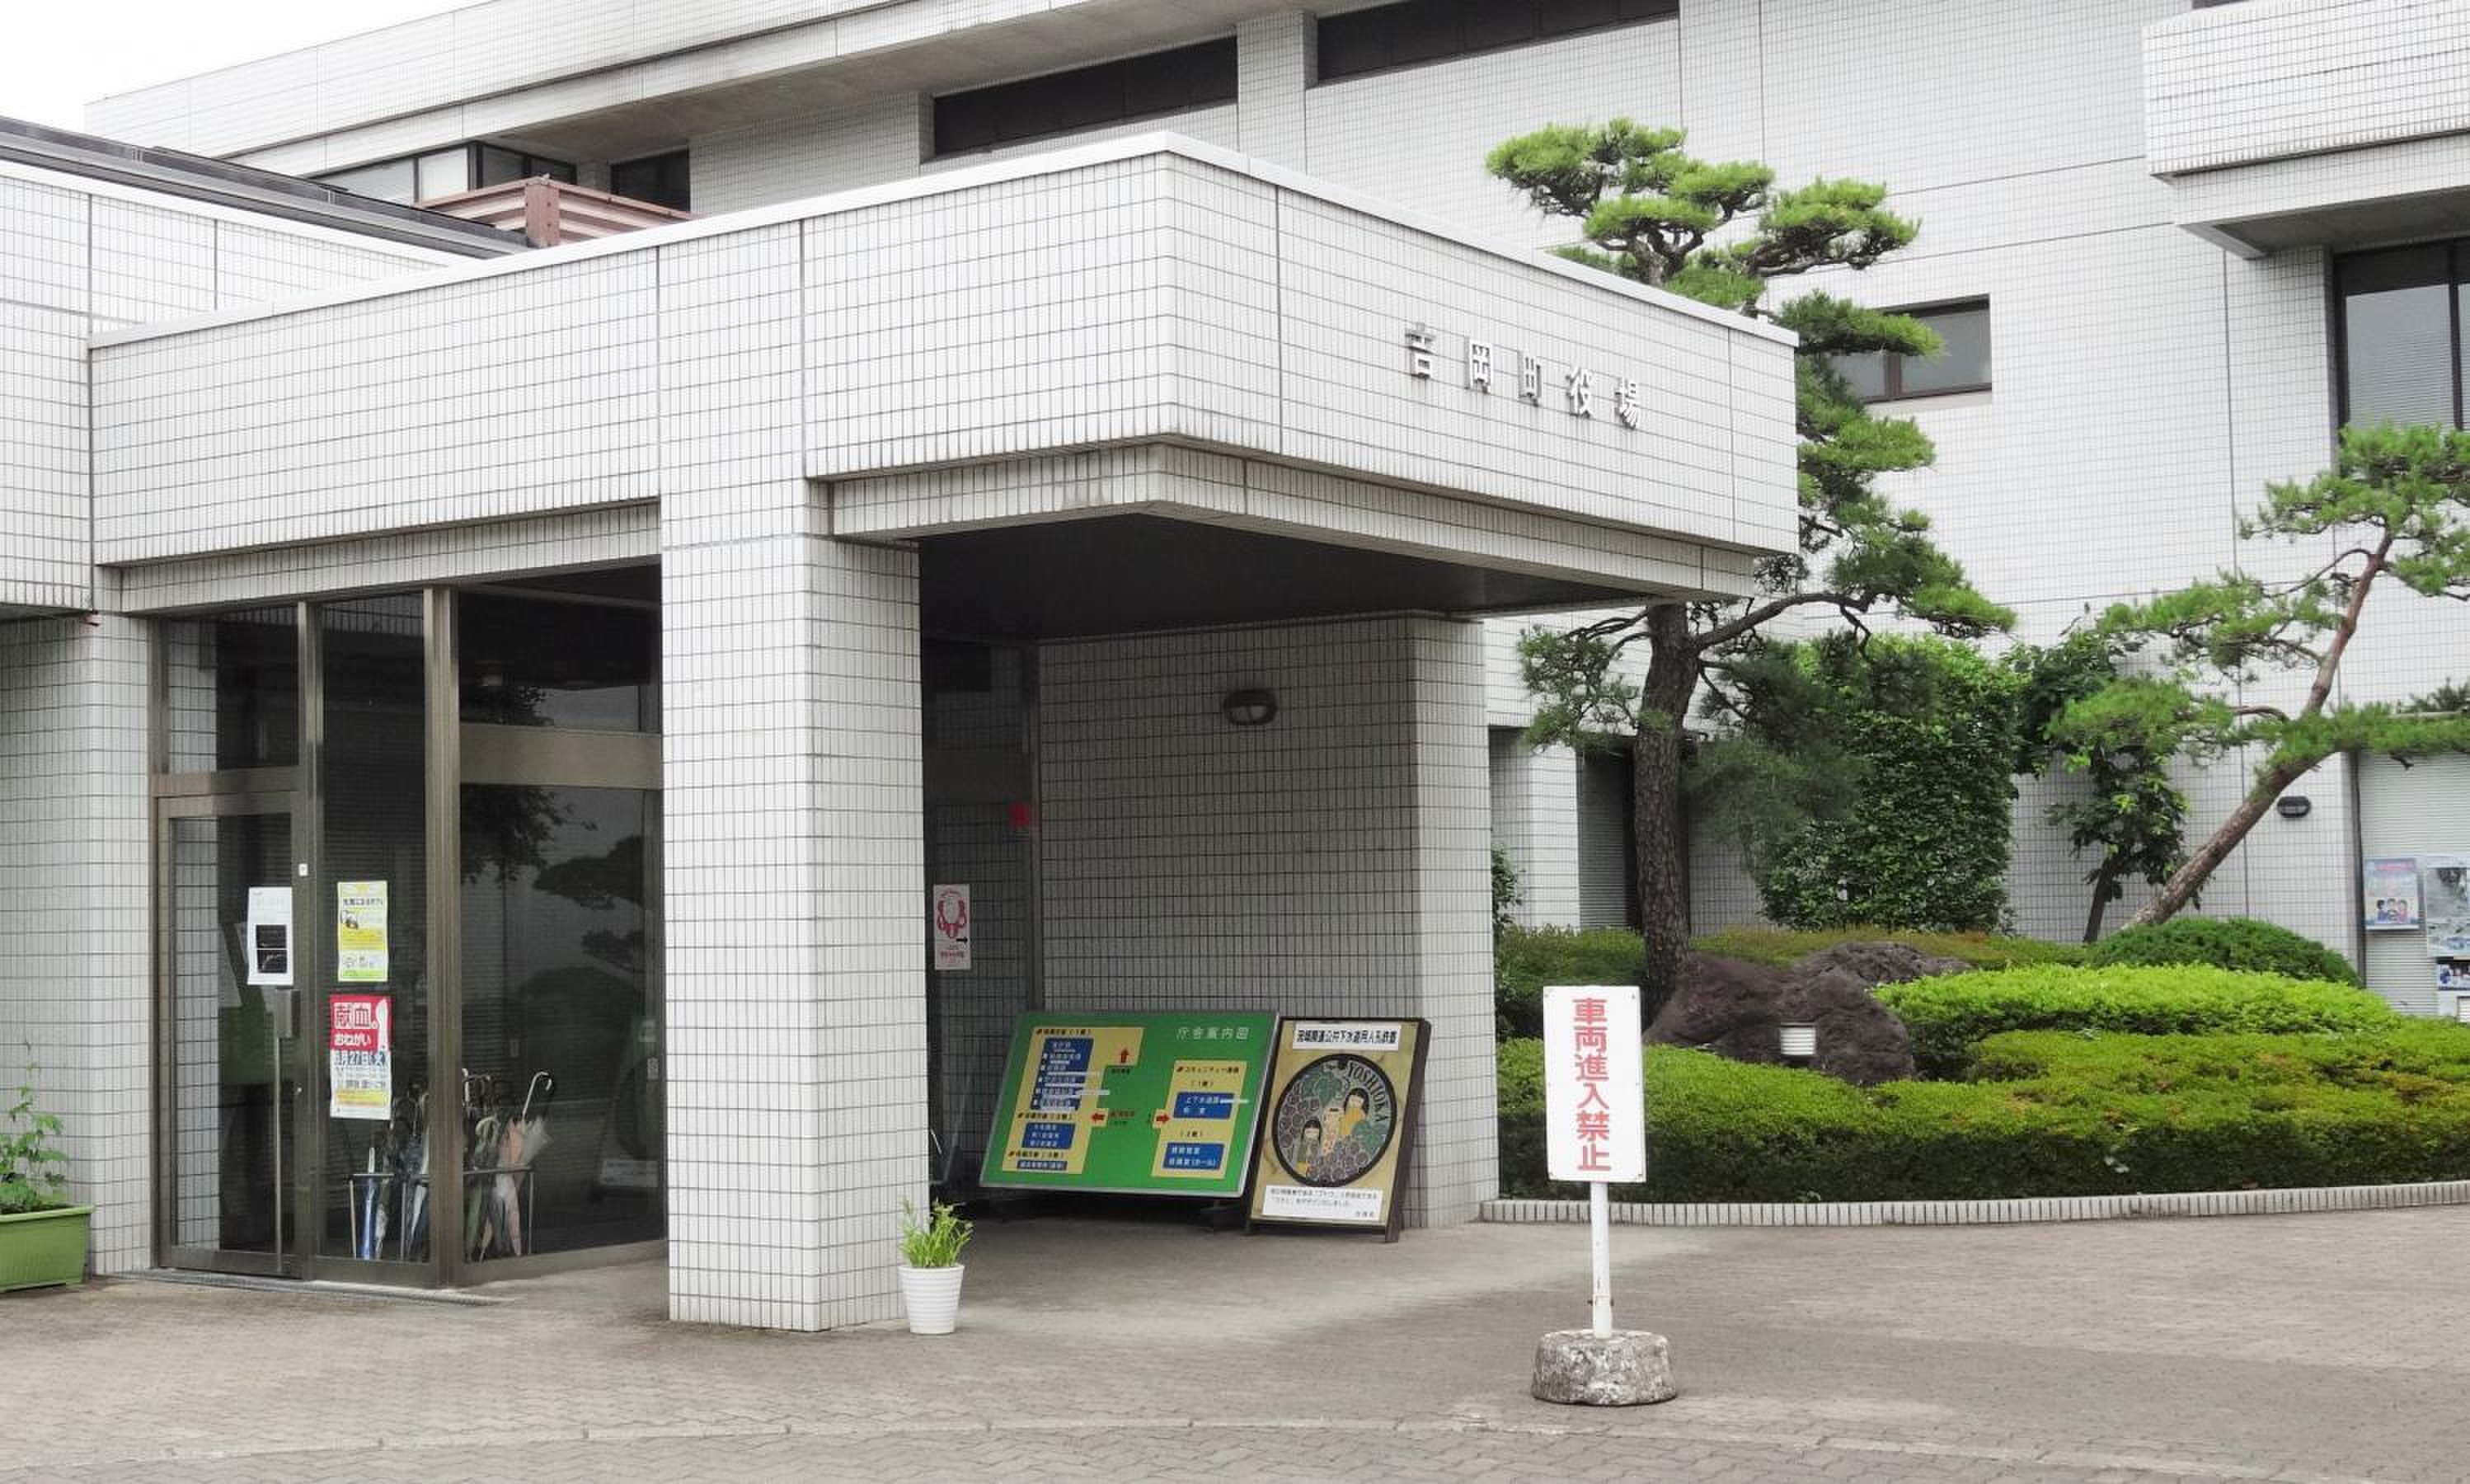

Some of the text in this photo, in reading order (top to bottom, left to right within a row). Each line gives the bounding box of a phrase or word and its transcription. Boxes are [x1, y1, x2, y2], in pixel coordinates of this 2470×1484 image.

[1405, 322, 1639, 430] 吉岡町役場
[334, 1032, 371, 1046] おねがい
[1347, 1062, 1388, 1122] YOSHIOKA
[1572, 998, 1611, 1171] 車両進入禁止
